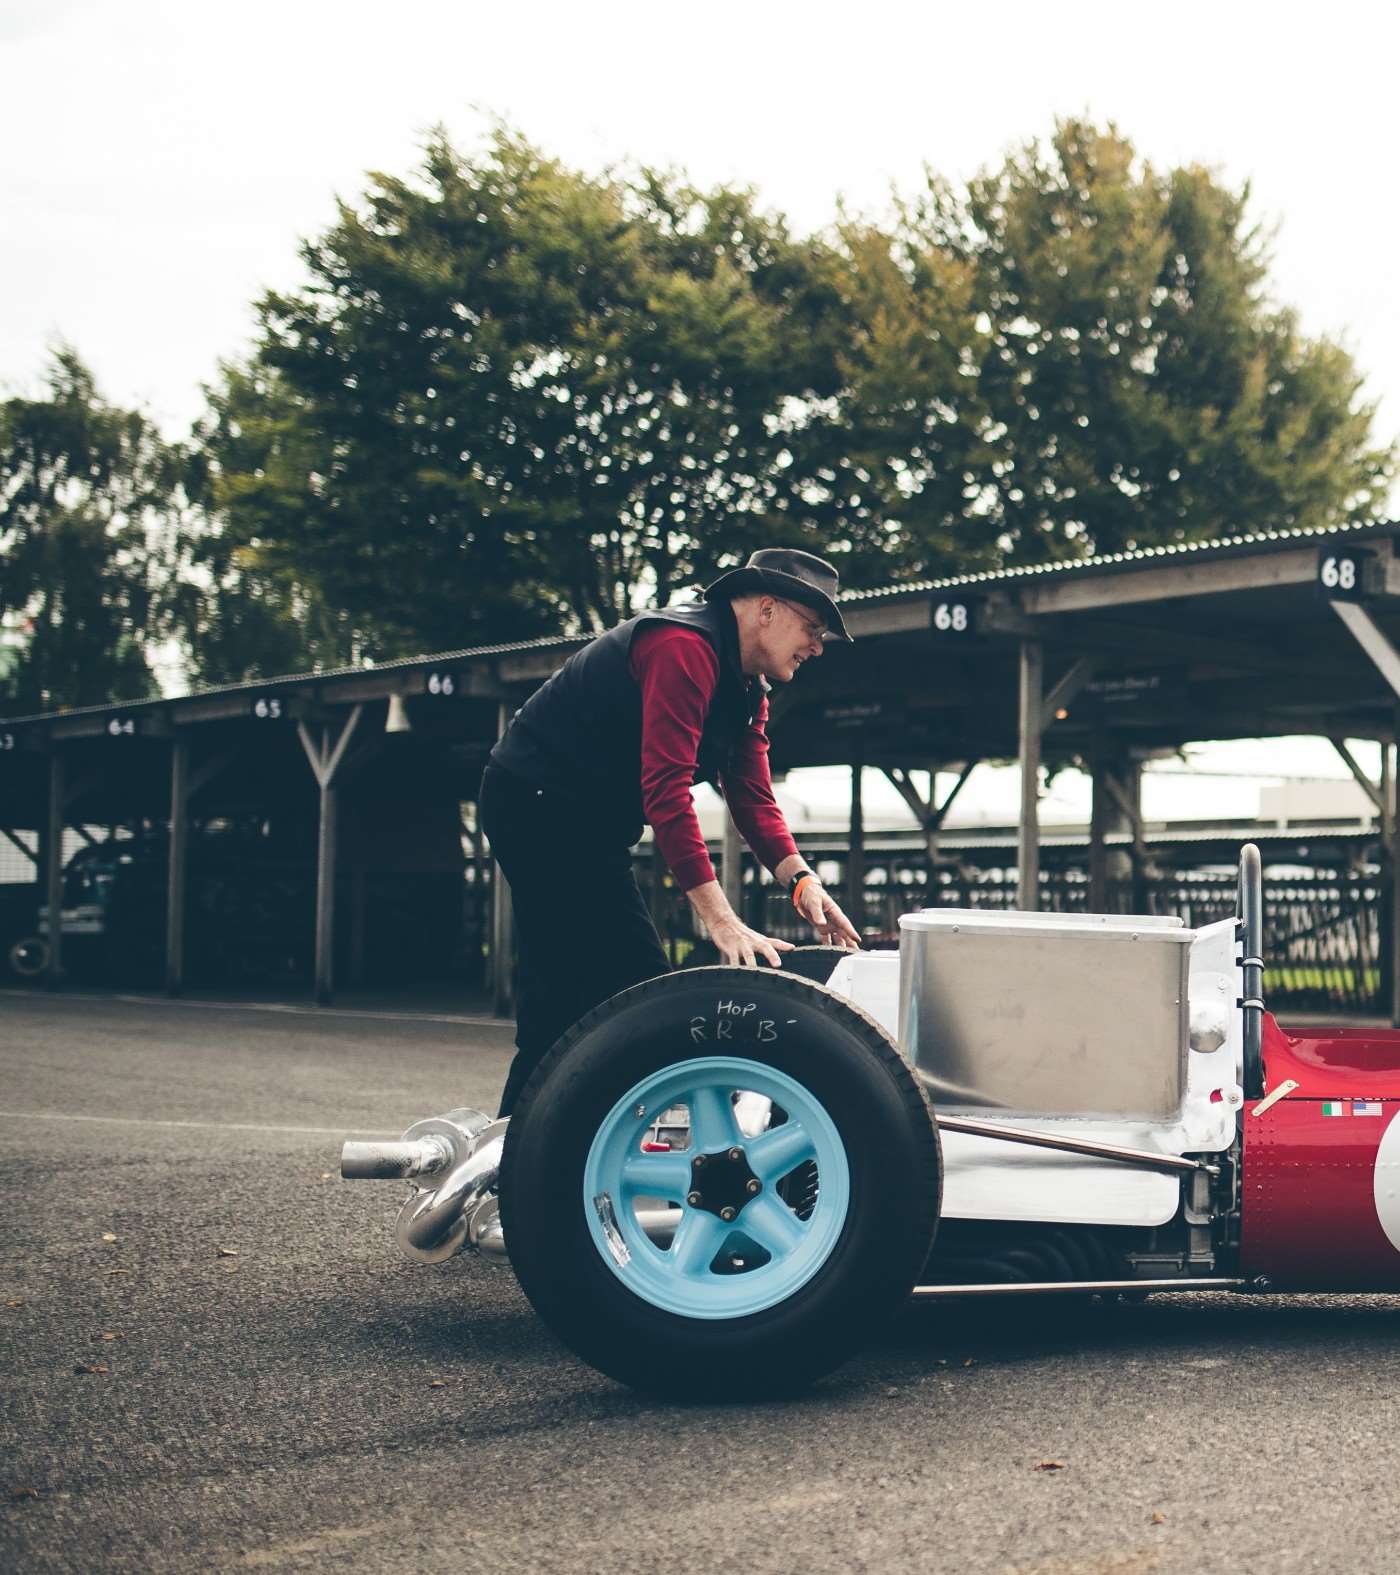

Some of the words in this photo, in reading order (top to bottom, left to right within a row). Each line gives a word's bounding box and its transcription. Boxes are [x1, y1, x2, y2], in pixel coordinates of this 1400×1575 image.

[1321, 557, 1355, 589] 68
[935, 603, 967, 631] 68
[428, 673, 453, 695] 66
[255, 699, 281, 718] 65
[0, 733, 14, 750] 3
